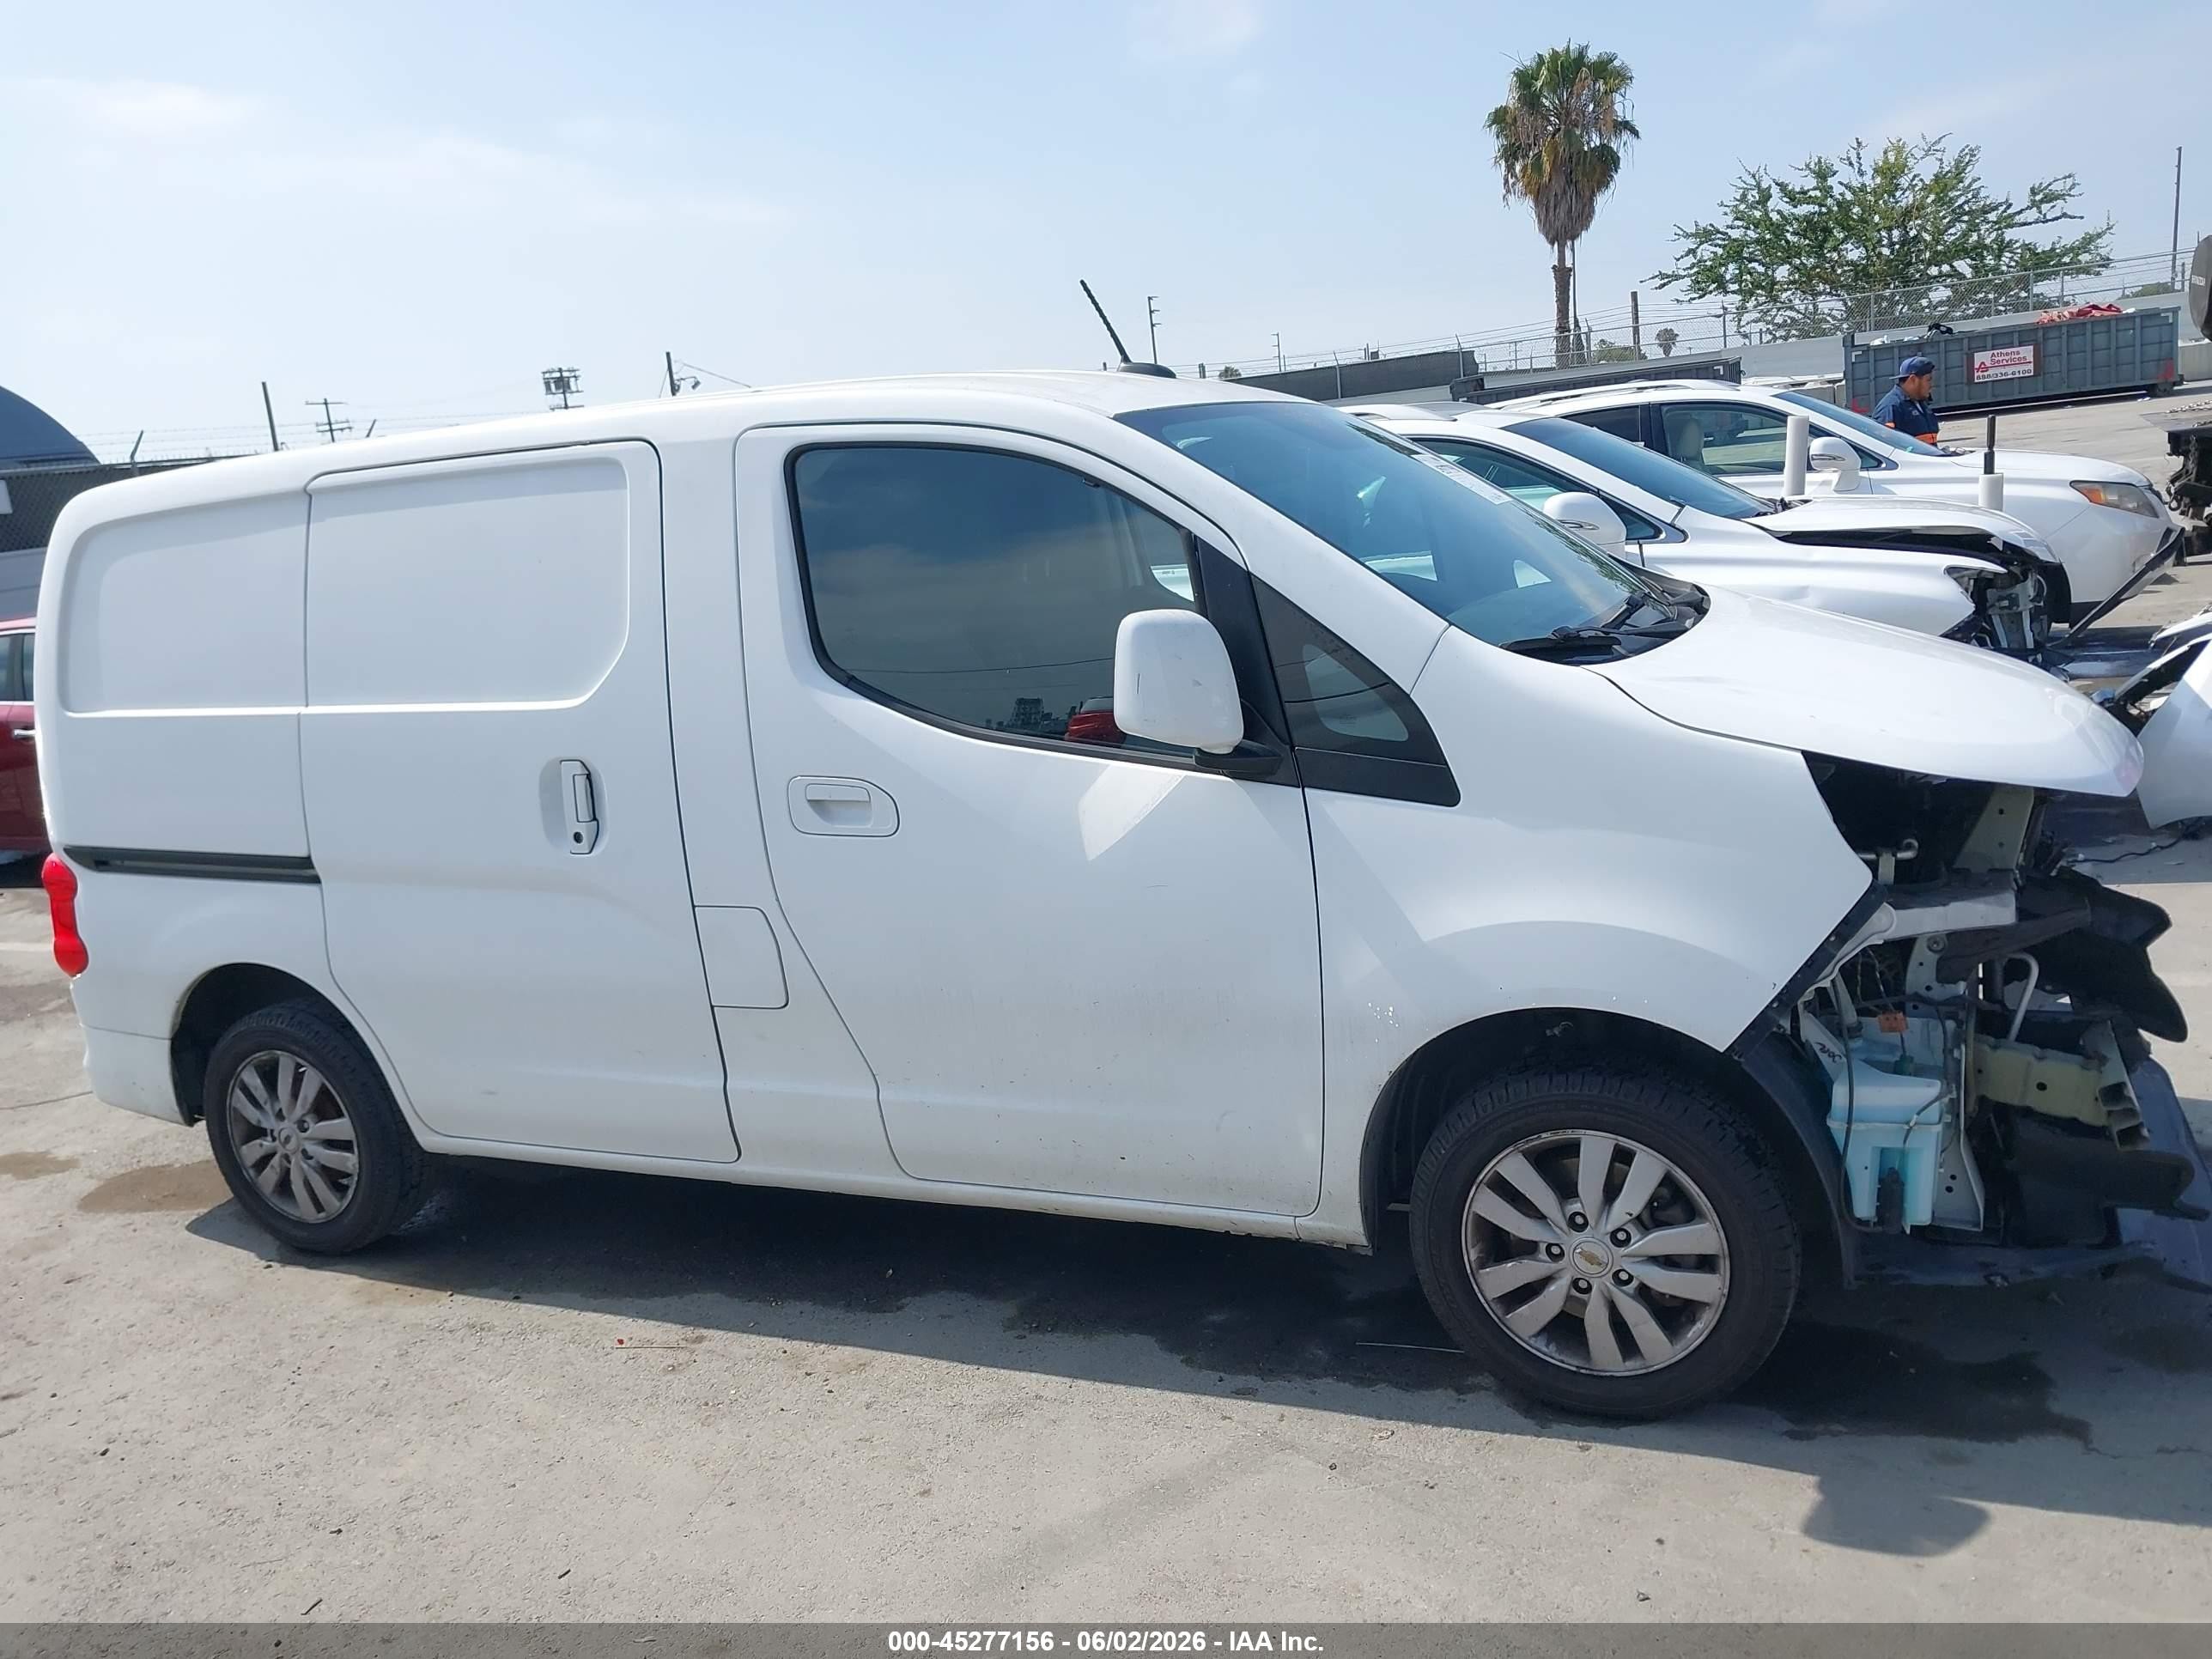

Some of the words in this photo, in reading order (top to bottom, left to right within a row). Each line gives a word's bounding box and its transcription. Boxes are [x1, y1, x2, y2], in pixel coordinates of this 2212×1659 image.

[1990, 350, 2021, 359] Athens
[1990, 356, 2027, 365] Services
[1976, 368, 2033, 380] 888/336-6100
